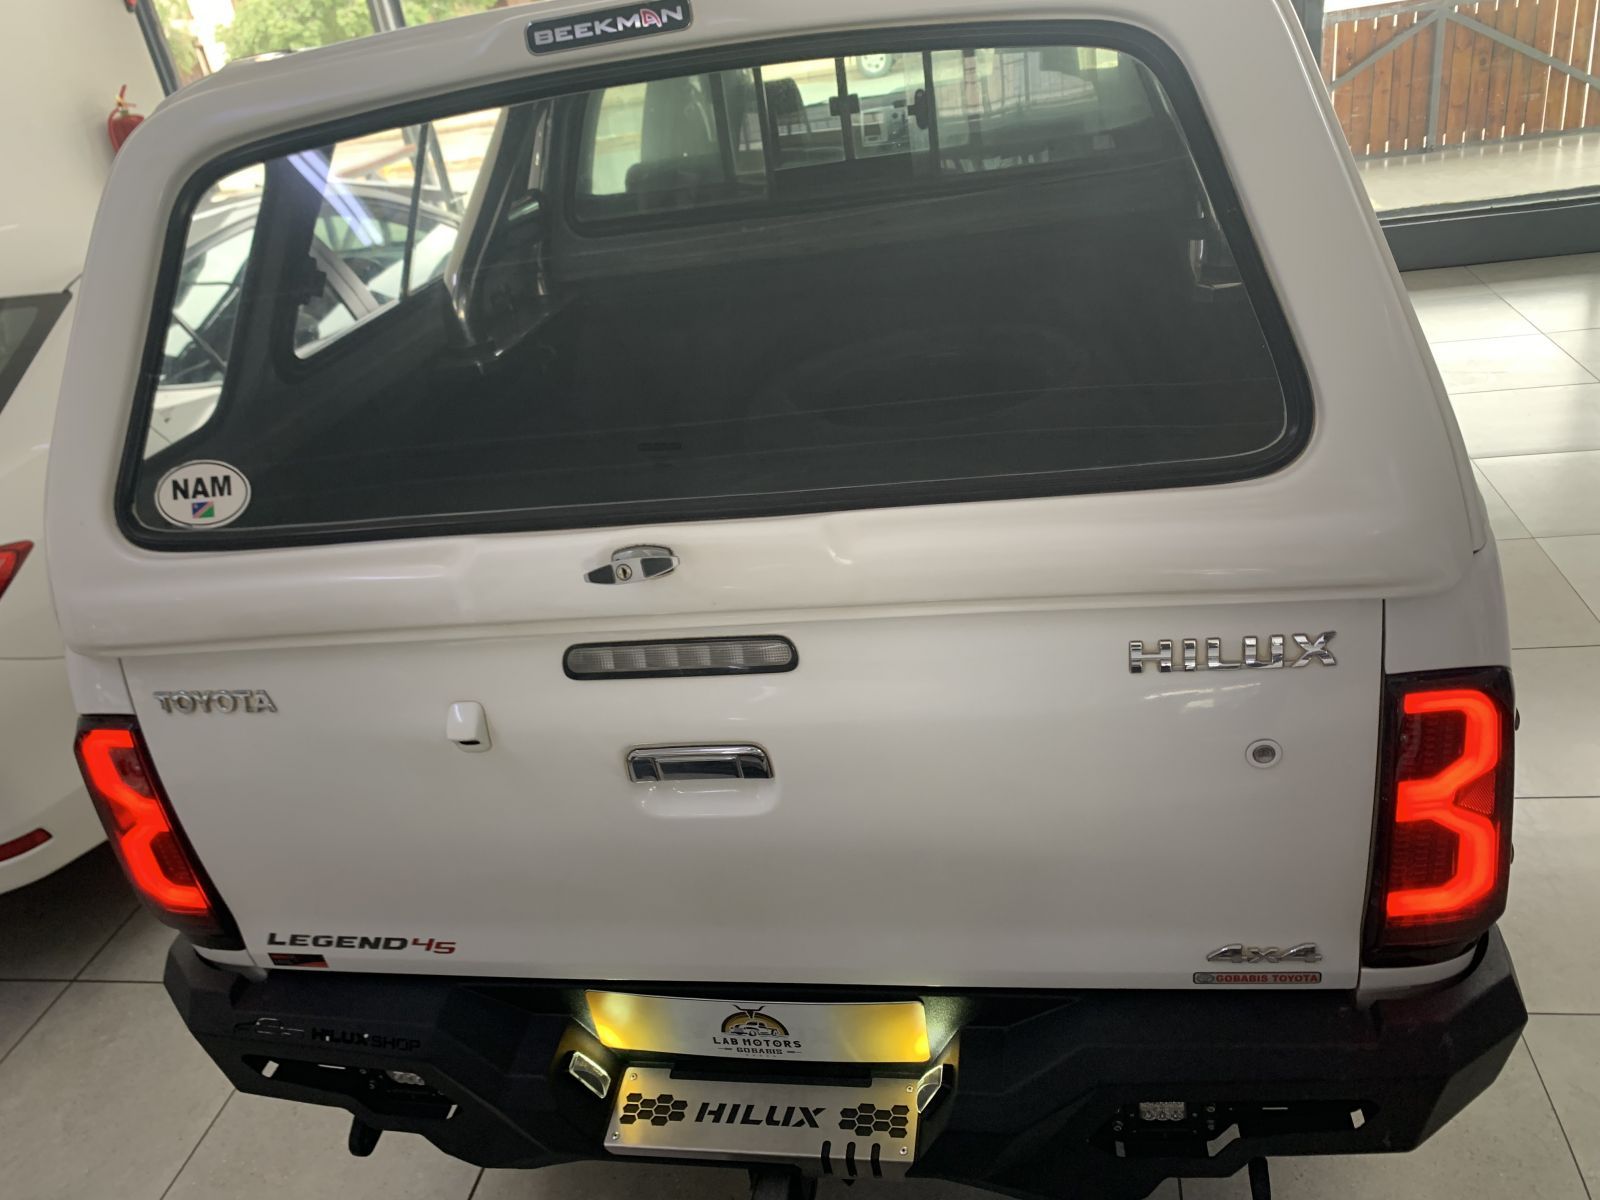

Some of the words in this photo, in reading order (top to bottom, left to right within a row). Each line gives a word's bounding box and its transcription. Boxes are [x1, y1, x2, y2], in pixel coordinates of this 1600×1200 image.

[534, 6, 684, 46] BEEKMAN
[171, 475, 233, 501] NAM
[1129, 631, 1337, 674] HILUX
[153, 689, 278, 714] TOYOTA
[1215, 974, 1269, 983] GOBABIS
[1271, 974, 1318, 983] TOYOTA
[712, 1036, 739, 1046] LAB
[742, 1038, 802, 1048] MOTORS
[736, 1046, 783, 1055] GOBABIS
[694, 1102, 826, 1128] HILUX
